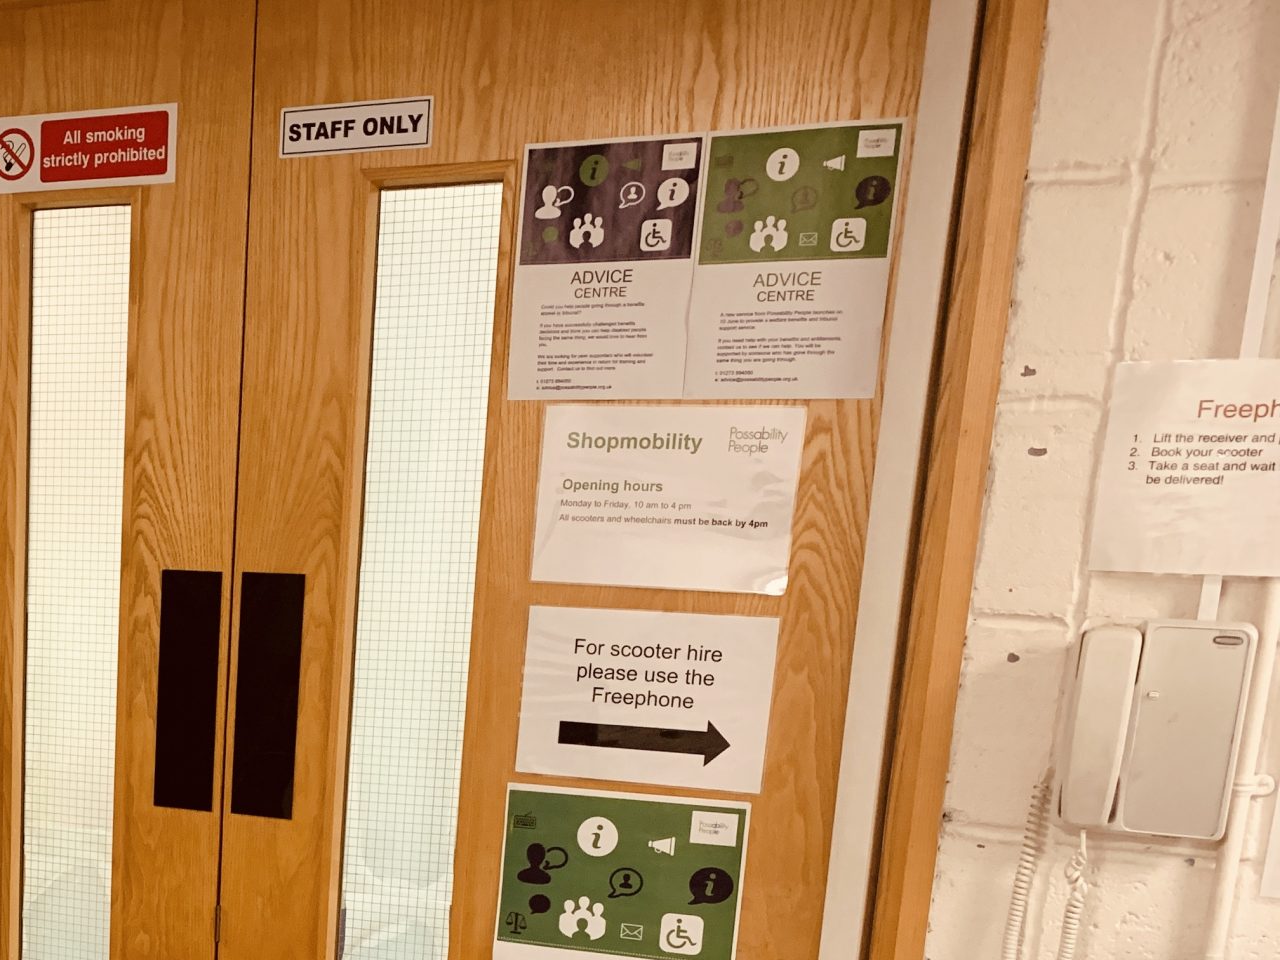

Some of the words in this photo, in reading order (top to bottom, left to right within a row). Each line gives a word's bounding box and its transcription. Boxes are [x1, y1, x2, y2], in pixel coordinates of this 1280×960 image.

[63, 130, 81, 145] All
[86, 126, 146, 143] smoking
[288, 118, 356, 142] STAFF
[362, 113, 424, 136] ONLY
[43, 150, 90, 168] strictly
[94, 145, 166, 167] prohibited
[570, 269, 634, 285] ADVICE
[753, 271, 823, 288] ADVICE
[574, 286, 628, 299] CENTRE
[757, 289, 816, 303] CENTRE
[567, 431, 703, 454] Shopmobility
[729, 426, 788, 443] Possability
[1153, 433, 1172, 443] Lift
[1175, 433, 1194, 443] the
[1198, 433, 1248, 443] receiver
[1251, 433, 1276, 443] and
[728, 440, 768, 457] People
[1129, 447, 1140, 457] 2.
[1151, 447, 1182, 457] Book
[1185, 448, 1213, 459] your
[1217, 448, 1264, 457] scooter
[1128, 461, 1138, 471] 3.
[1148, 460, 1178, 471] Take
[1181, 463, 1189, 471] a
[1193, 462, 1220, 471] seat
[1222, 461, 1247, 471] and
[1250, 461, 1276, 471] wait
[562, 478, 619, 494] Opening
[623, 479, 663, 492] hours
[1146, 475, 1161, 484] be
[1164, 475, 1224, 485] delivered!
[560, 499, 592, 510] Monday
[594, 500, 602, 508] to
[604, 500, 631, 510] Friday,
[634, 501, 643, 509] 10
[660, 501, 669, 509] to
[671, 501, 677, 509] 4
[678, 503, 692, 511] pm
[559, 514, 570, 522] All
[571, 514, 605, 523] scooters
[606, 514, 621, 523] and
[624, 515, 671, 525] wheelchairs
[674, 517, 696, 526] must
[698, 517, 710, 526] be
[711, 518, 733, 527] back
[735, 518, 747, 529] by
[748, 519, 769, 529] 4pm
[574, 638, 605, 655] For
[610, 641, 681, 660] scooter
[686, 644, 723, 663] hire
[576, 663, 638, 682] please
[644, 670, 678, 684] use
[685, 669, 715, 686] the
[591, 687, 694, 709] Freephone
